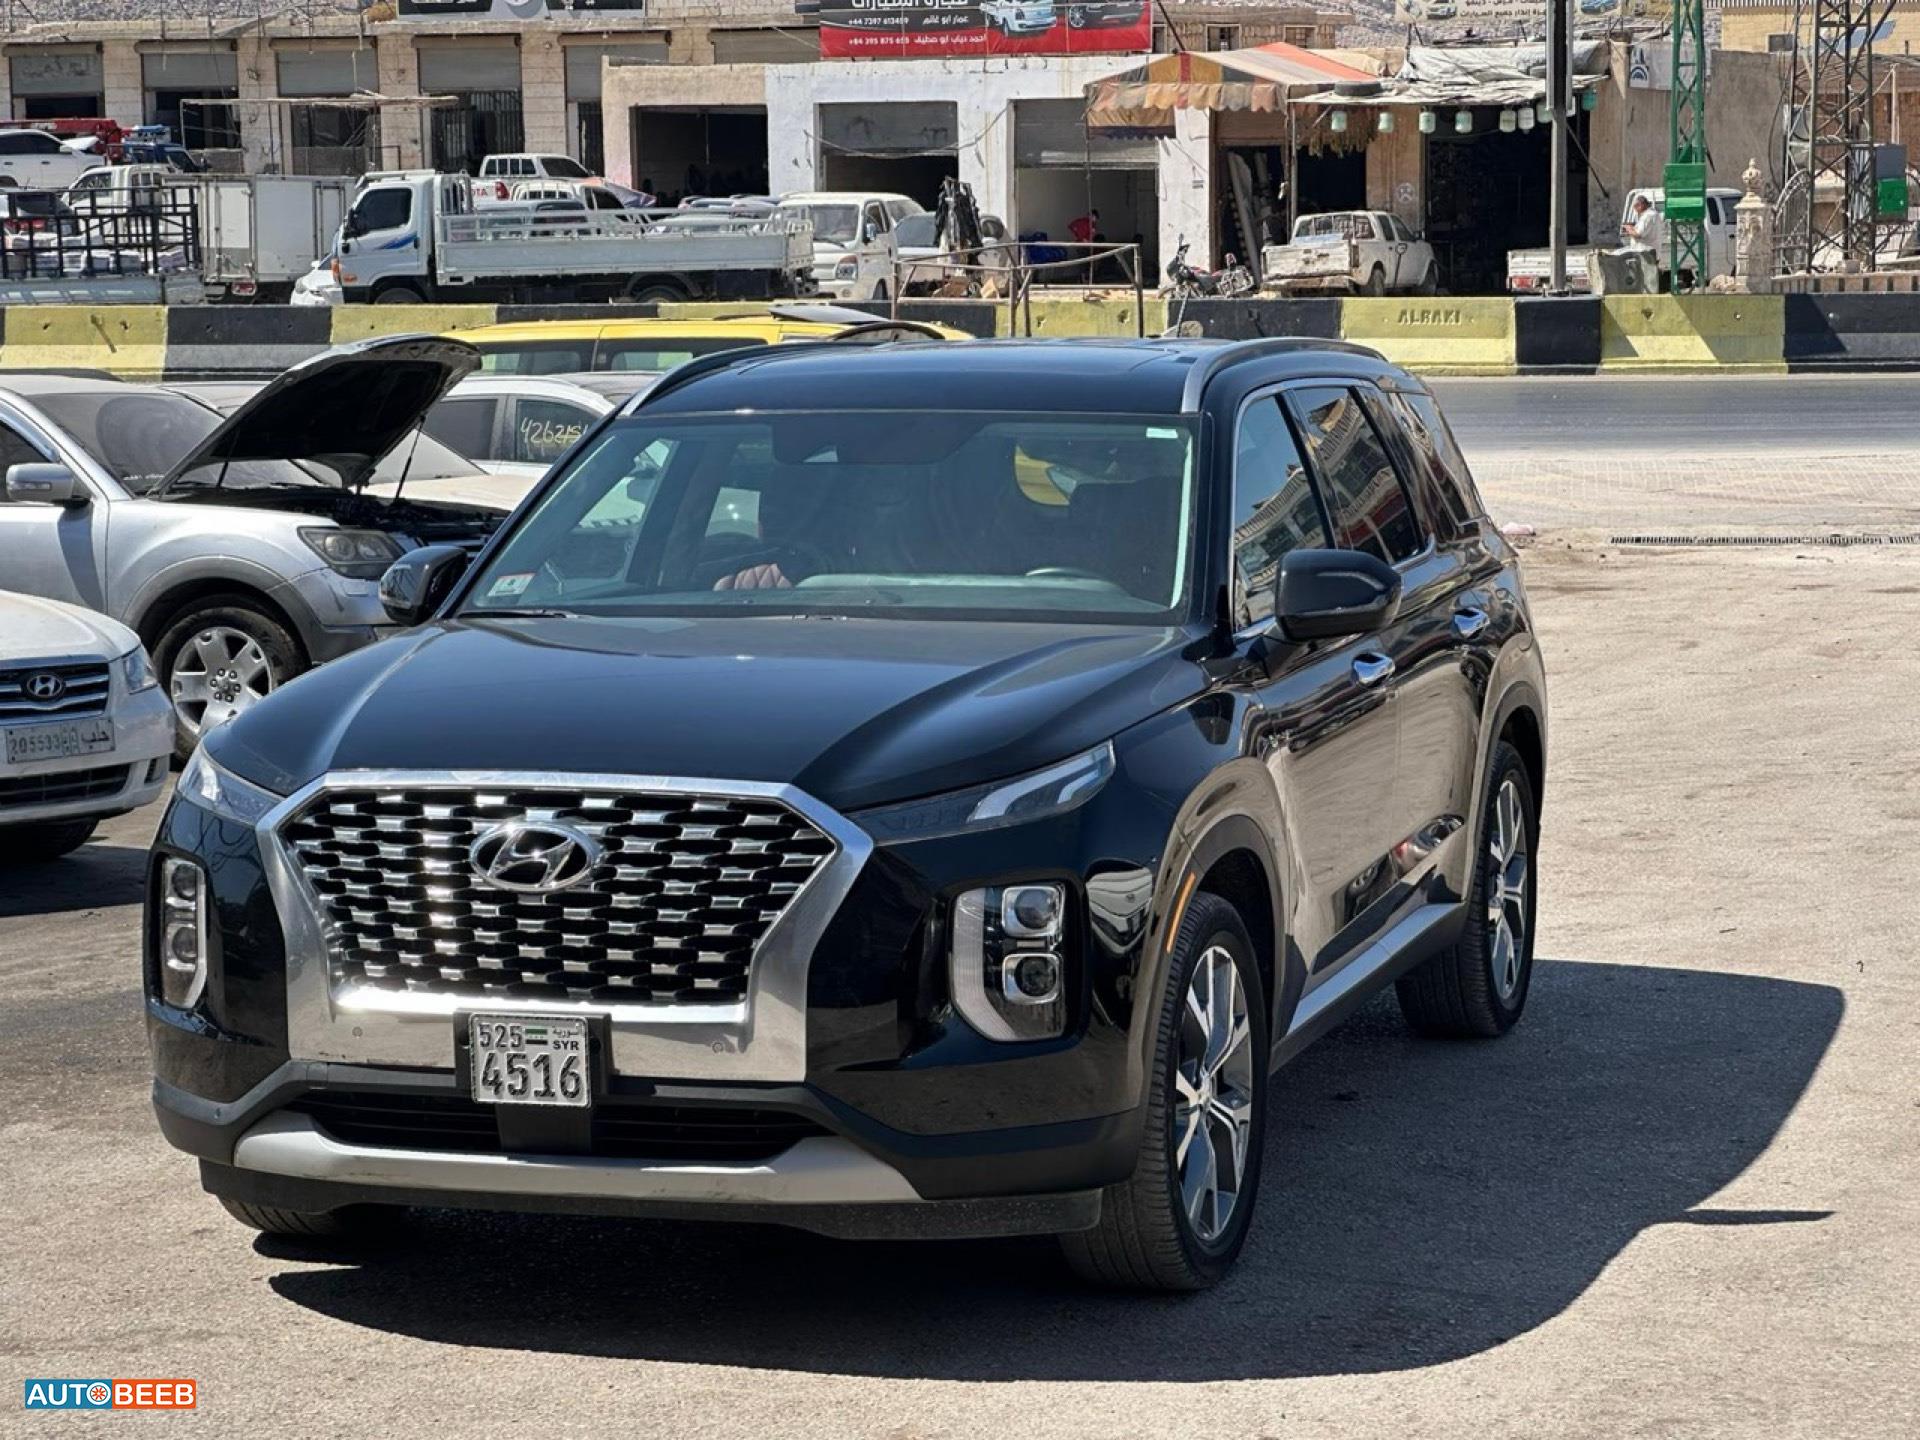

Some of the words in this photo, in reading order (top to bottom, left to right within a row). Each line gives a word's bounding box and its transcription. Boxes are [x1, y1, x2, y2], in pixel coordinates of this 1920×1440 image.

[81, 722, 110, 750] حلب
[479, 1023, 523, 1048] 525
[553, 1040, 579, 1051] SYR
[482, 1052, 580, 1099] 4516
